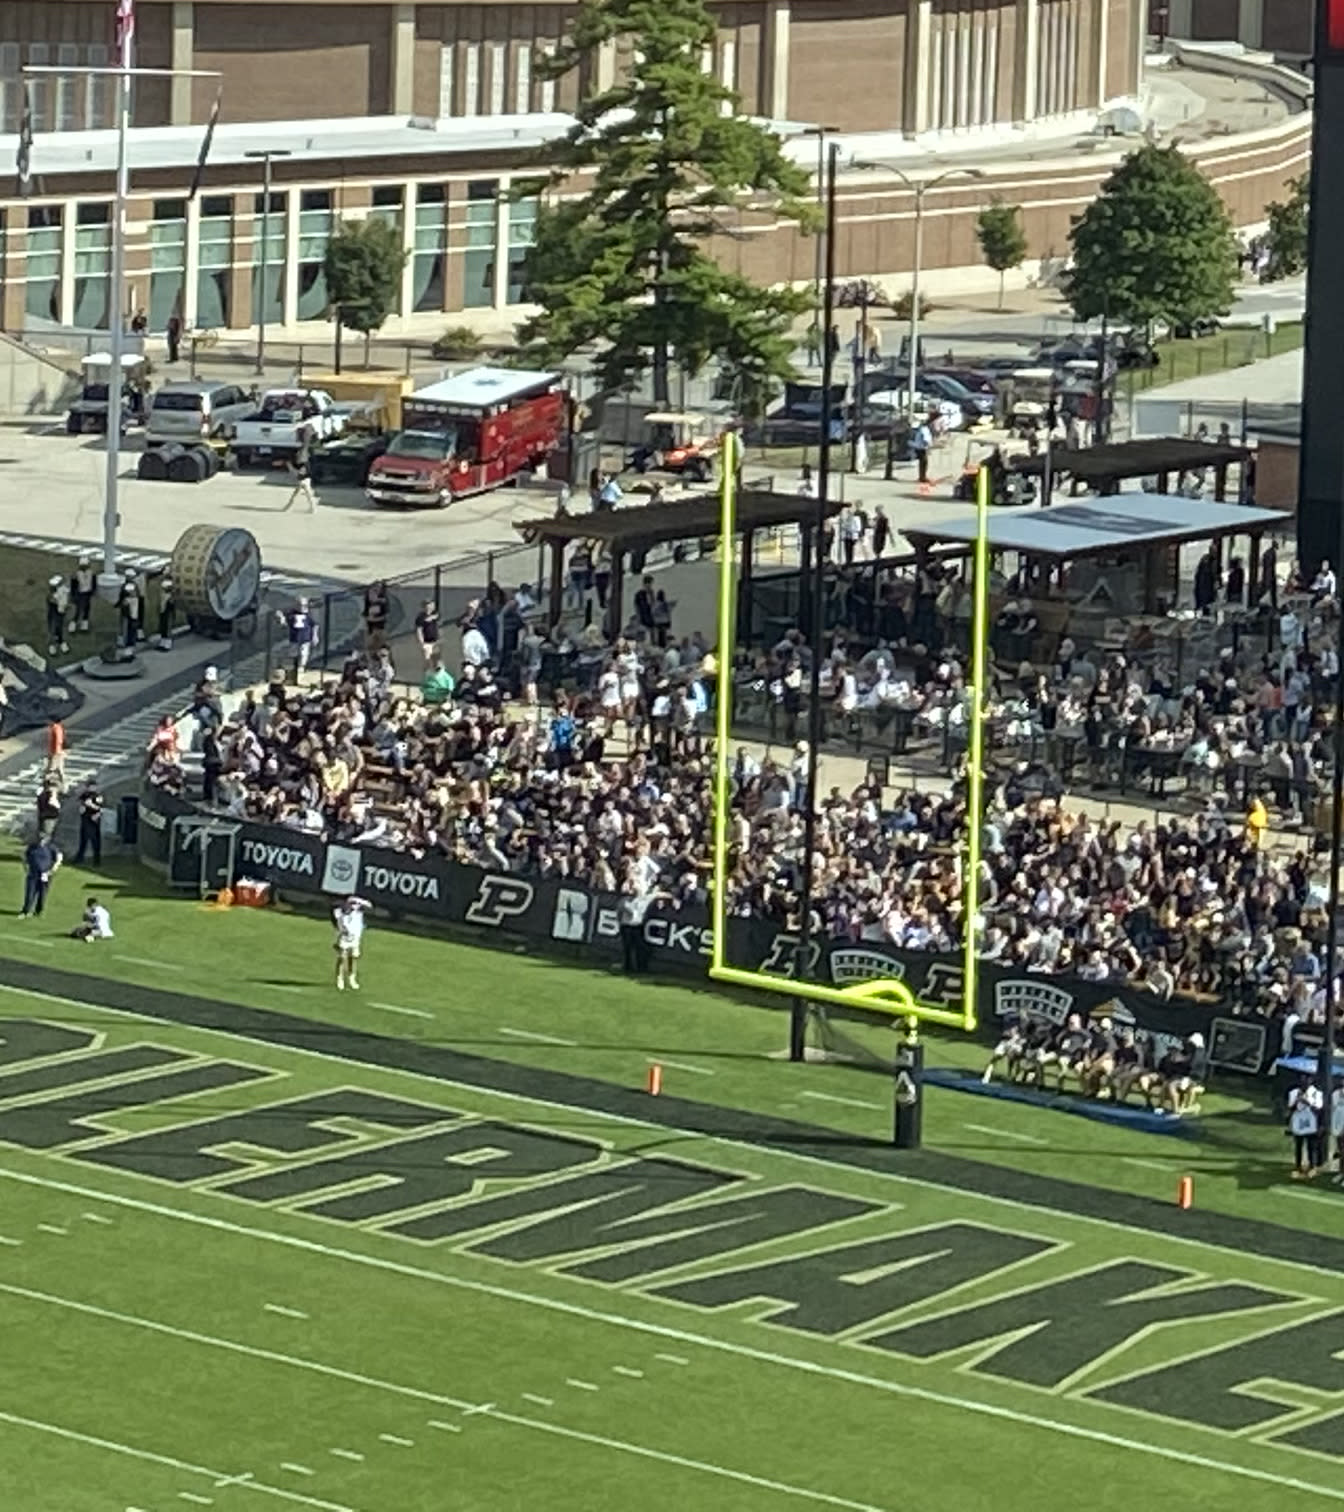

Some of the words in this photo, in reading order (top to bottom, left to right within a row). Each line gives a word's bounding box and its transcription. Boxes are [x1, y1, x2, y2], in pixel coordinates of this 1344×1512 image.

[242, 841, 314, 874] TOYOTA
[363, 865, 440, 899] TOYOTA
[465, 874, 534, 926] P
[597, 908, 715, 955] BCK'S
